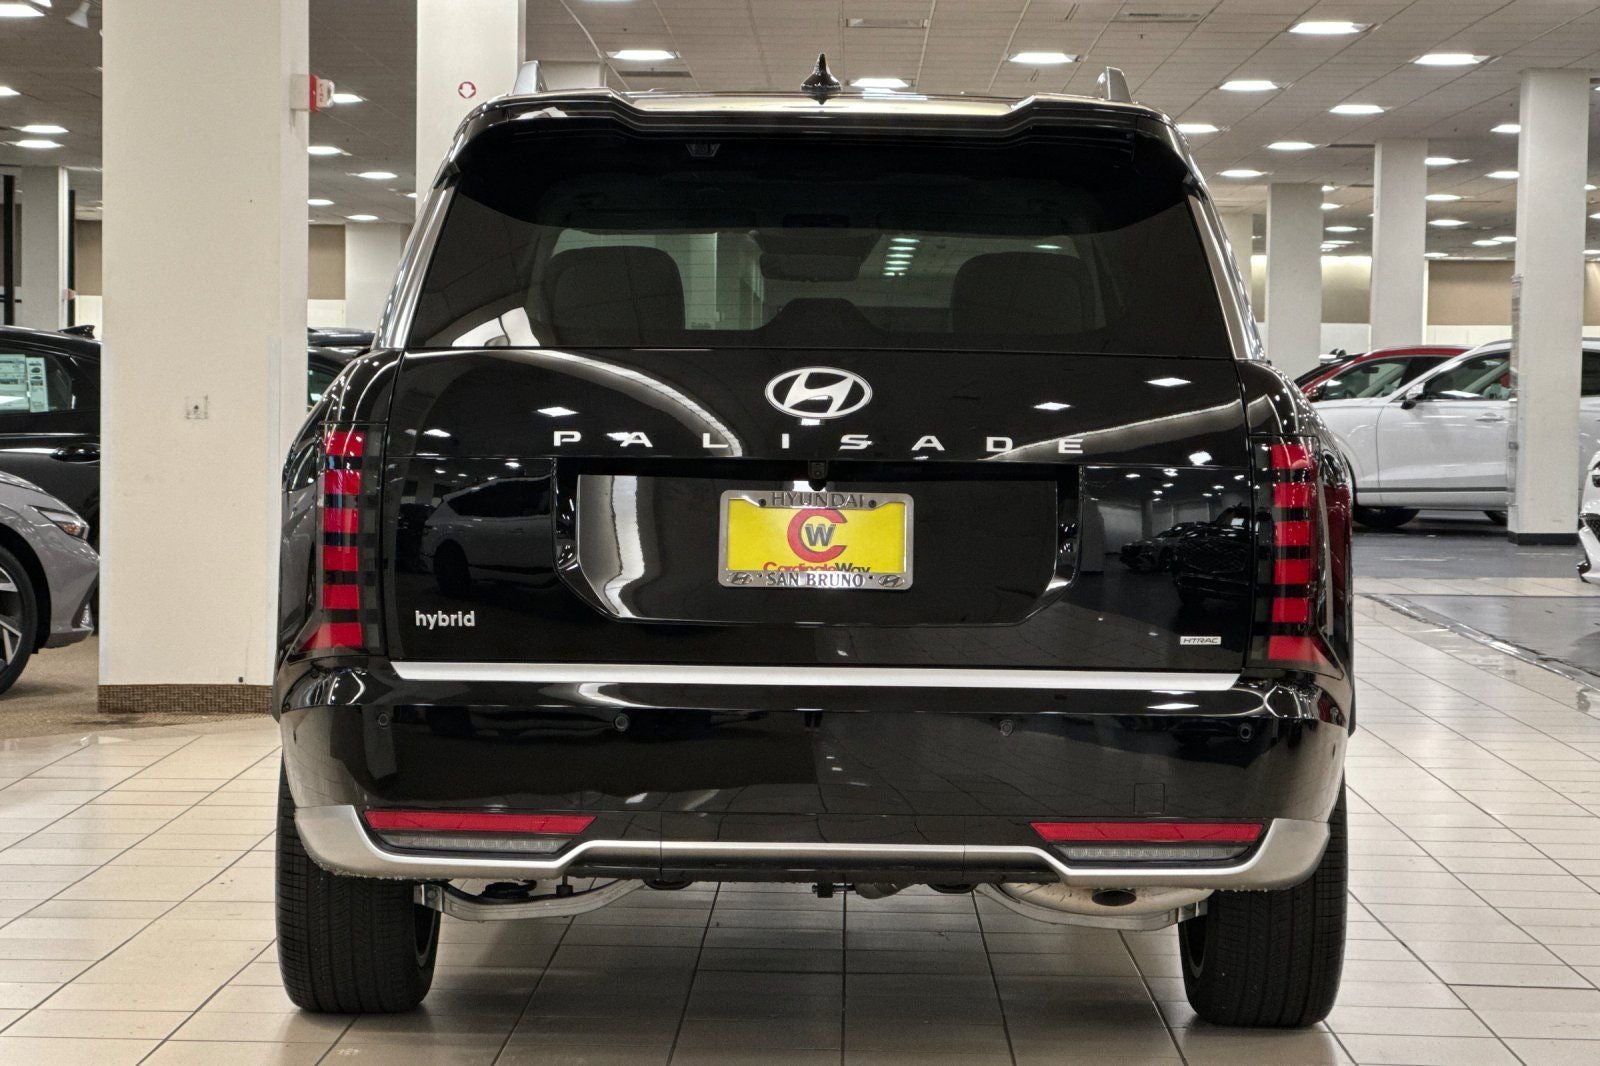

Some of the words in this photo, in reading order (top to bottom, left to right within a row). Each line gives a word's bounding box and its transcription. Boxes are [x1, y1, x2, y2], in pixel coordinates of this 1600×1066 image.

[553, 430, 1084, 455] PALISADE
[772, 491, 864, 508] HYUNDAI
[767, 572, 799, 586] SAN
[806, 573, 864, 588] BRUNO
[415, 610, 475, 630] hybrid
